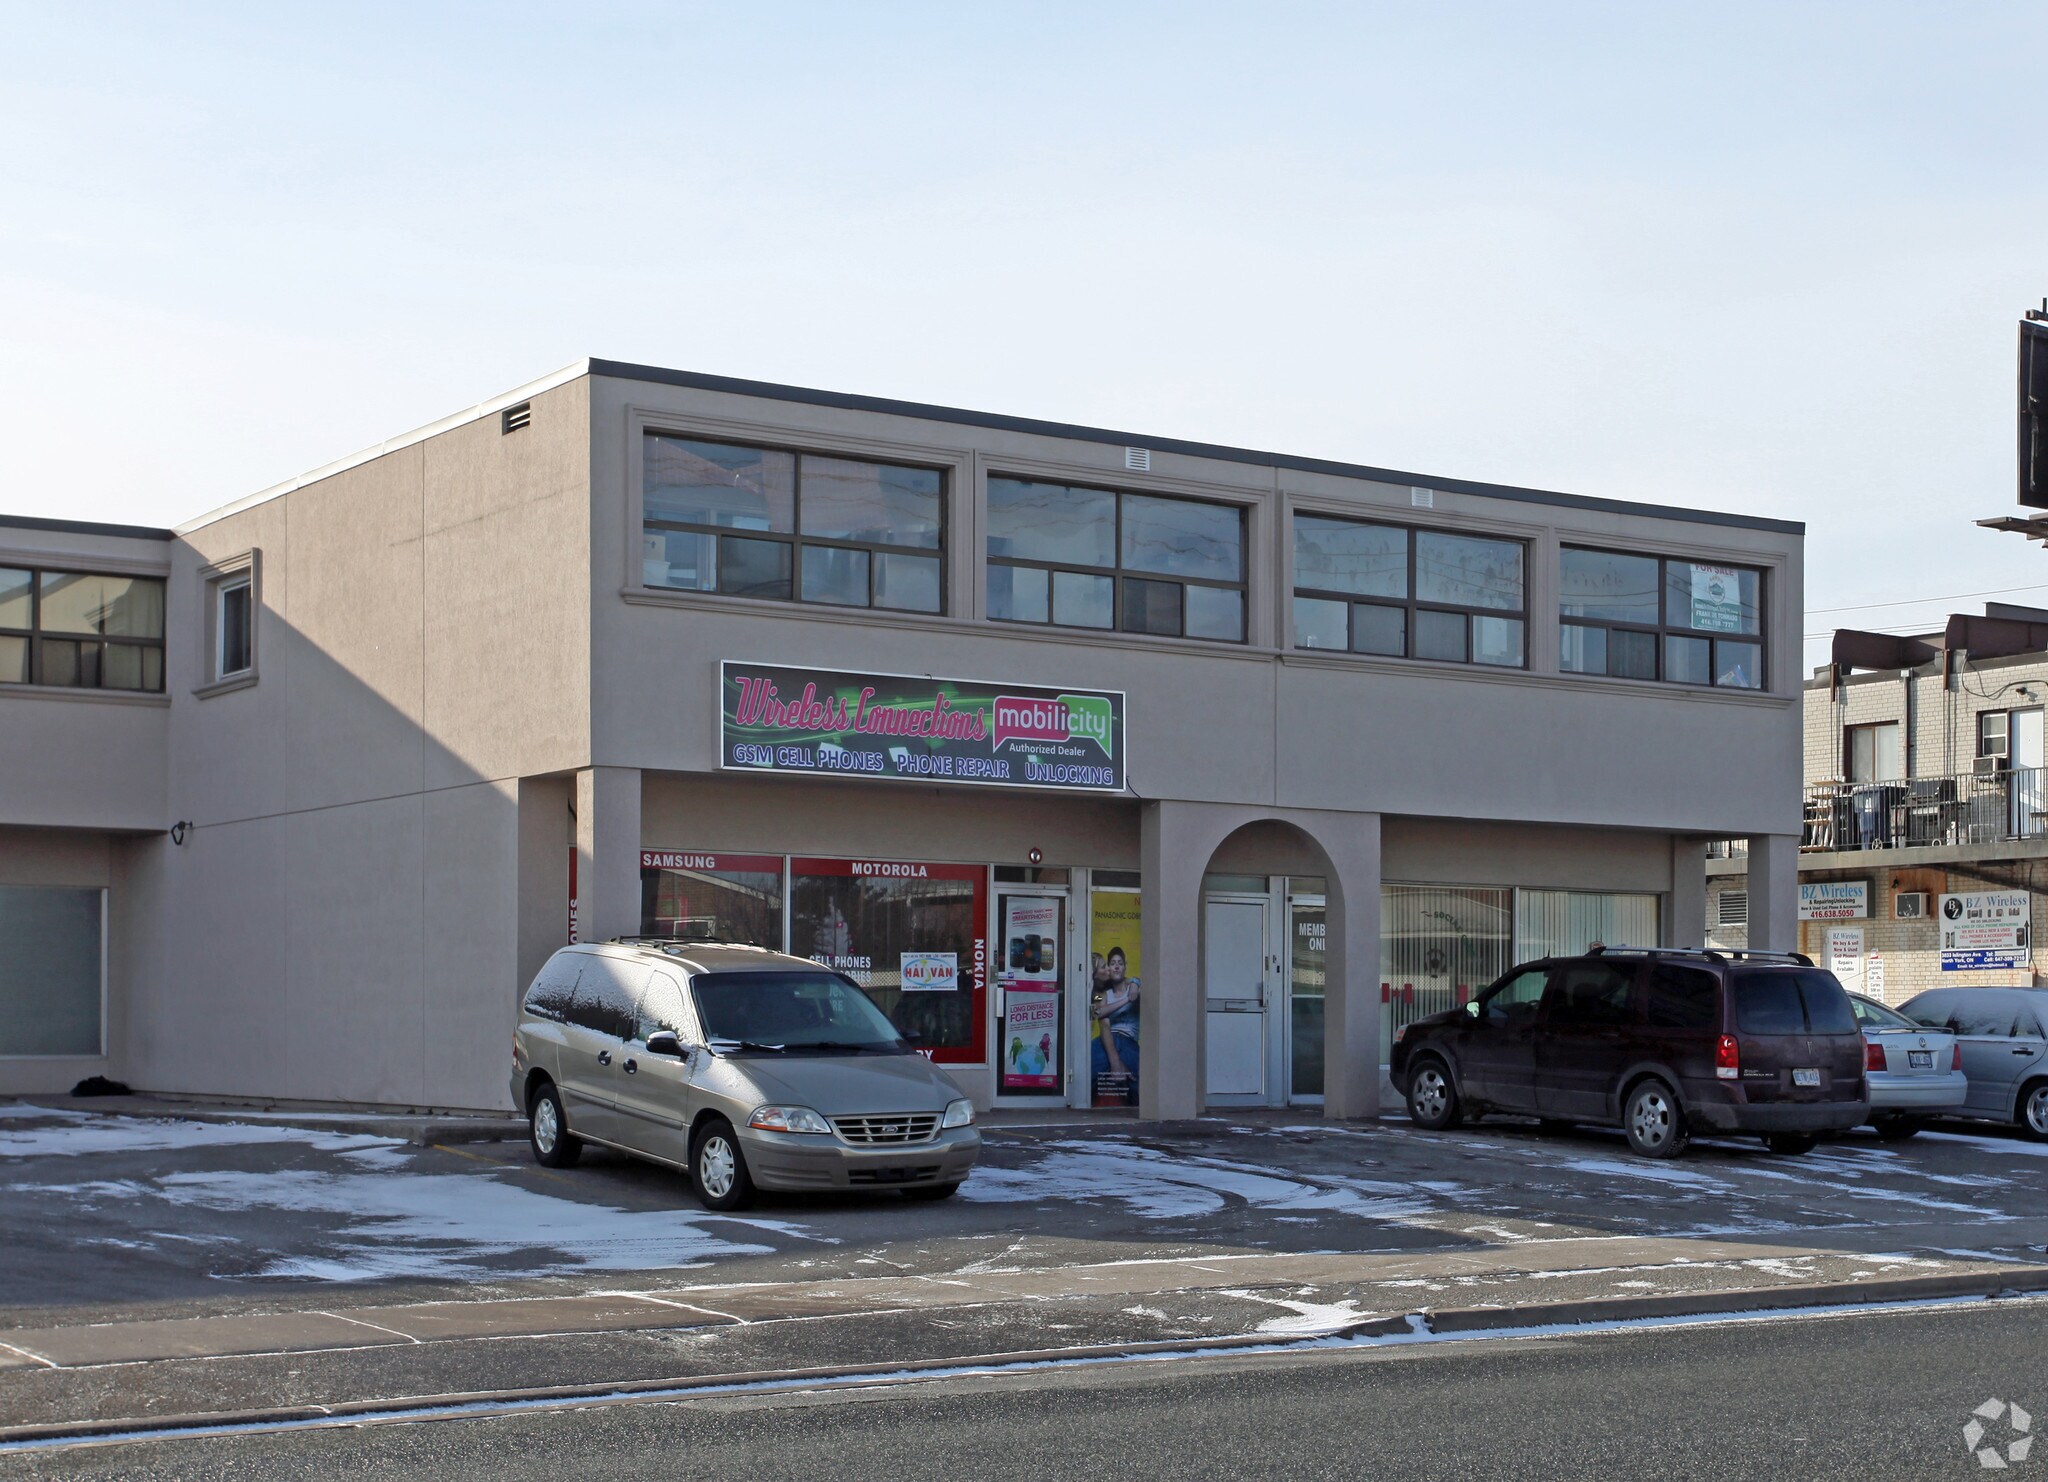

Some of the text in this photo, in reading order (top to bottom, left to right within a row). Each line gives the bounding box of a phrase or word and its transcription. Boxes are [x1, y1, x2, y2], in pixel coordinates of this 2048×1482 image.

[735, 677, 989, 742] Wireless Connections
[999, 704, 1106, 740] mobilicity
[732, 743, 884, 771] GSM CELL PHONES
[1009, 742, 1086, 757] Authorized Dealer
[897, 755, 1010, 779] PHONE REPAIR
[1025, 763, 1113, 785] UNLOCKING
[643, 854, 716, 869] SAMSUNG
[852, 862, 927, 877] MOTOROLA
[1801, 884, 1863, 899] BZ Wireless
[1966, 895, 2027, 909] BZ Wireless
[1012, 912, 1053, 922] SMARTPHONES
[1095, 911, 1126, 919] PANASONIC
[1810, 910, 1854, 918] 416.638.5050
[1299, 922, 1326, 936] MEMB
[834, 956, 872, 969] PHONES
[974, 939, 985, 989] NOKIA
[1010, 1002, 1054, 1013] LONG DISTANCE
[1010, 1009, 1054, 1023] FOR LESS
